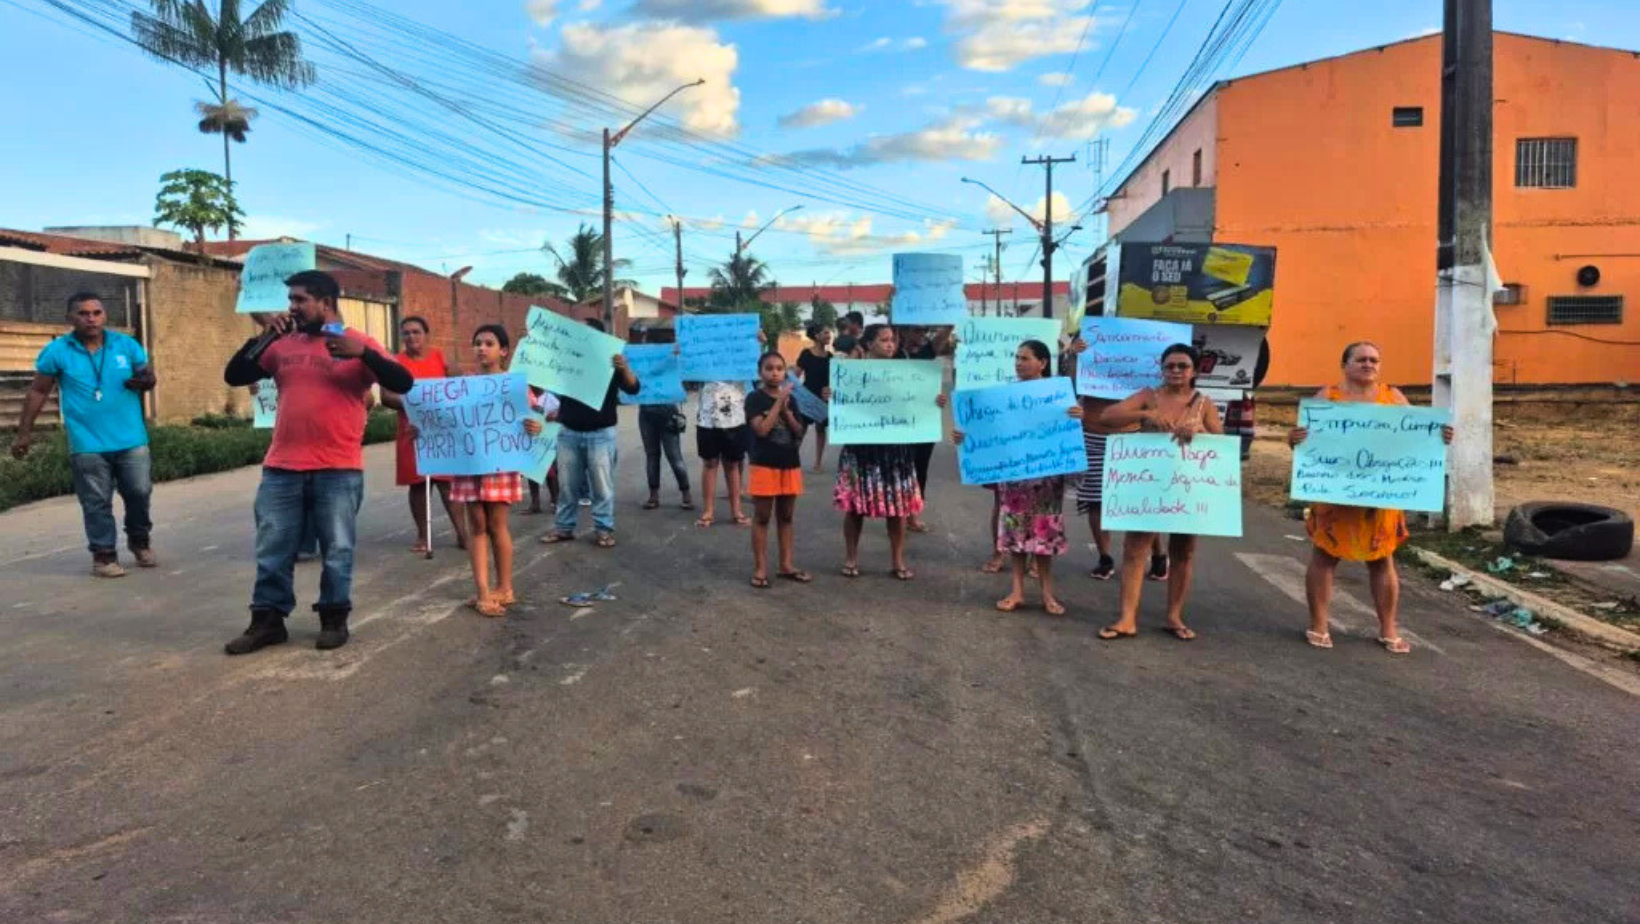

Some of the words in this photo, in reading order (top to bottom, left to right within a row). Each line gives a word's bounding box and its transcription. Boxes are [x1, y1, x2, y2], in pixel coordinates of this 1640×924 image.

[405, 378, 469, 407] CHEGA
[483, 377, 512, 397] DE
[415, 432, 456, 459] PARA
[464, 431, 476, 456] O
[1110, 437, 1174, 461] Quem
